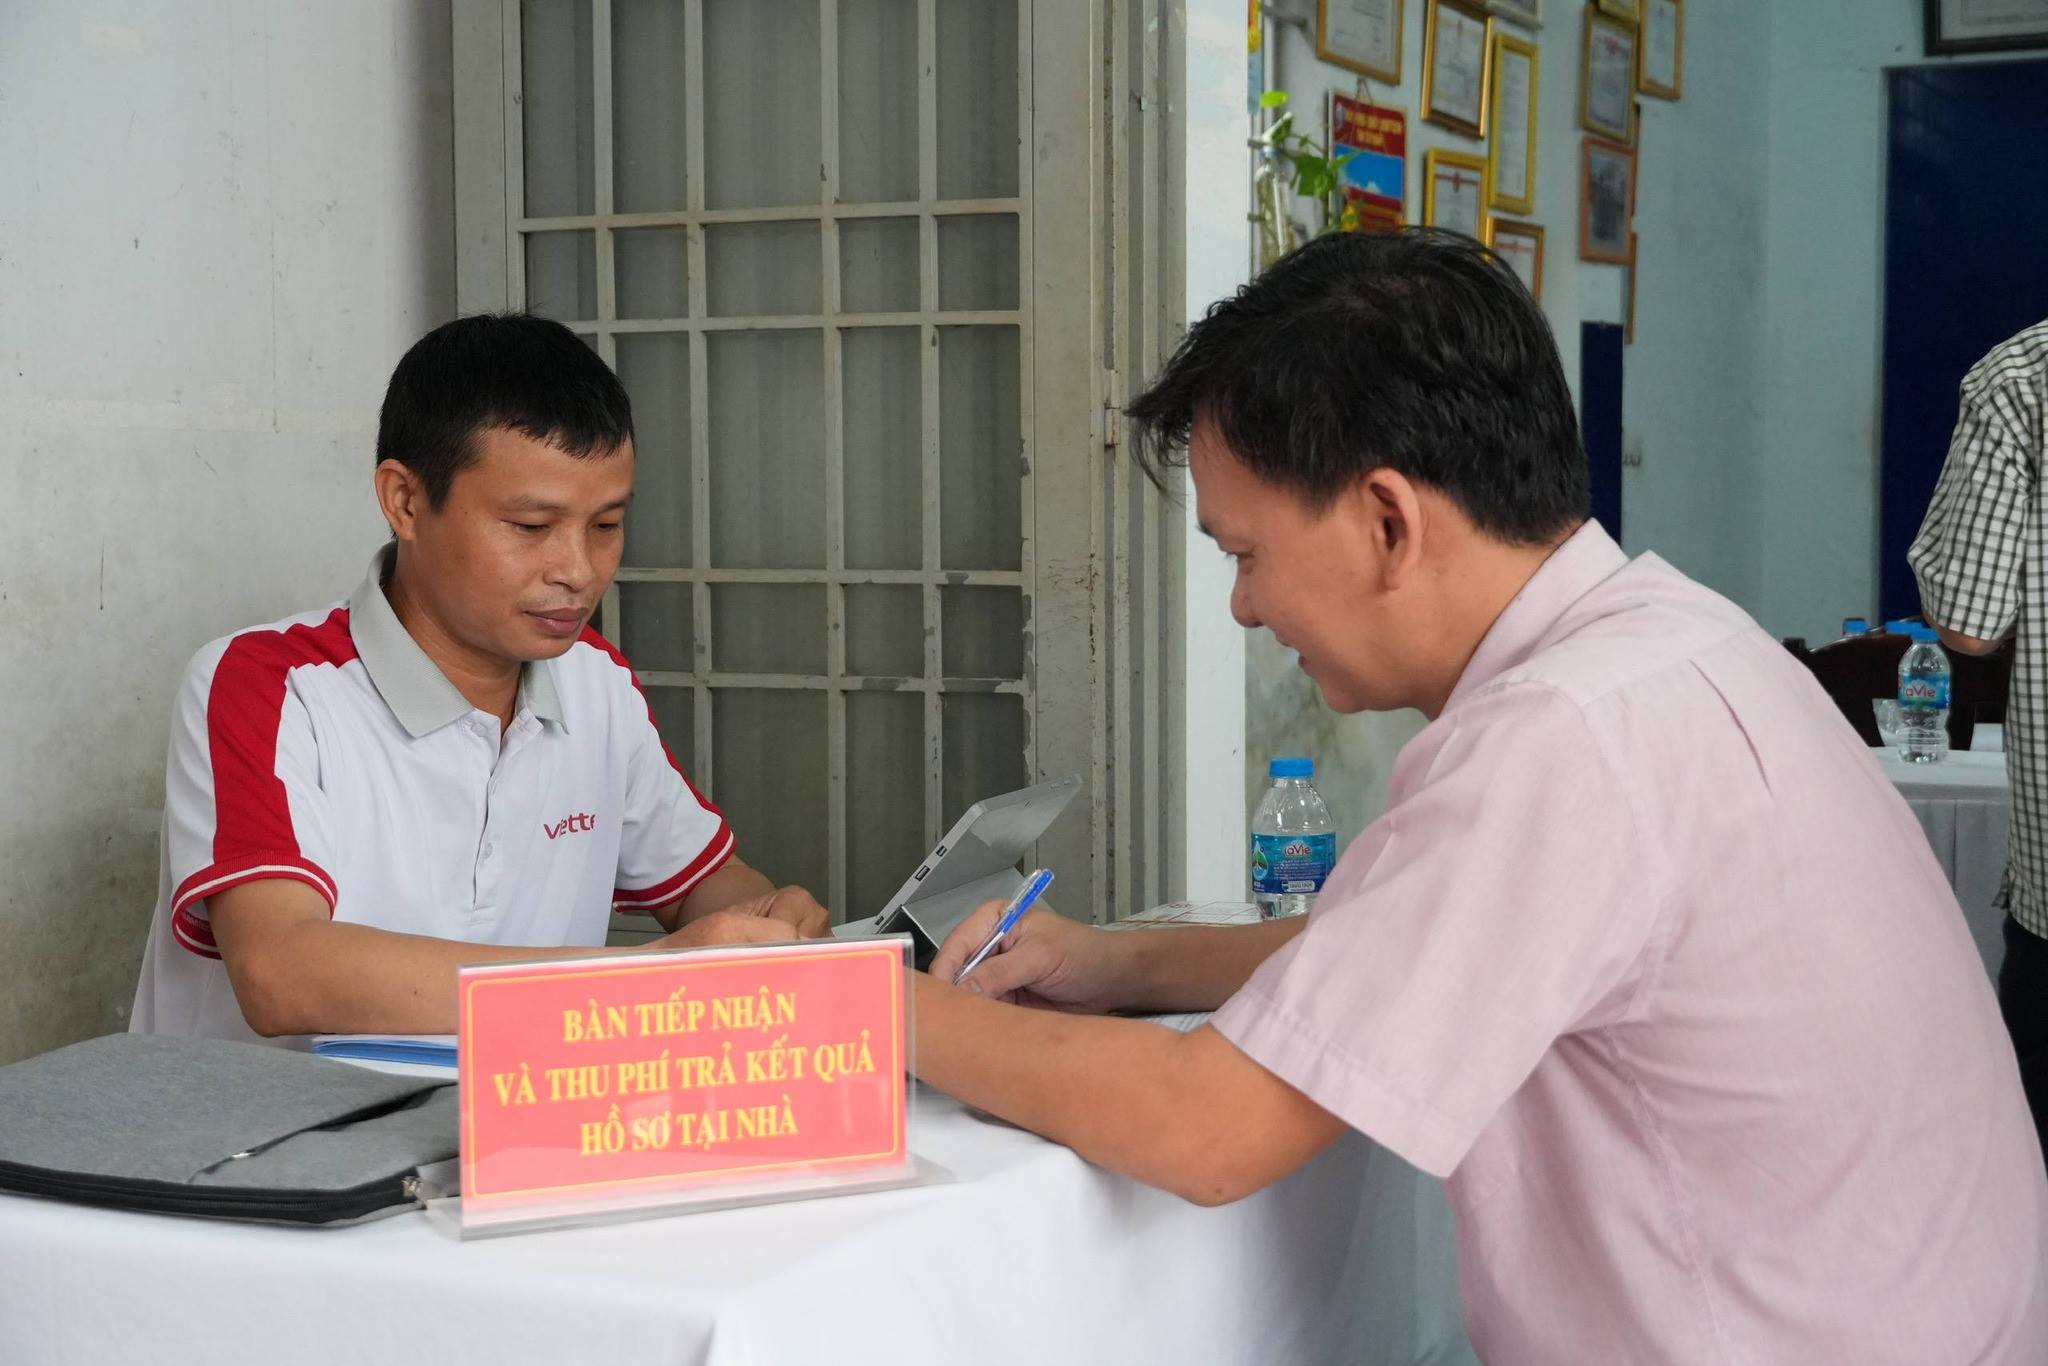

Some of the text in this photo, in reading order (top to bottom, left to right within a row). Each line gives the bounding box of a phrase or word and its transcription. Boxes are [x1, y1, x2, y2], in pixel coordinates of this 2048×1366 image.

[563, 984, 797, 1044] BÀN TIẾP NHẬN
[493, 1028, 876, 1107] VÀ THU PHÍ TRẢ KẾT QUẢ
[580, 1092, 799, 1157] HỒ SƠ TẠI NHÀ
